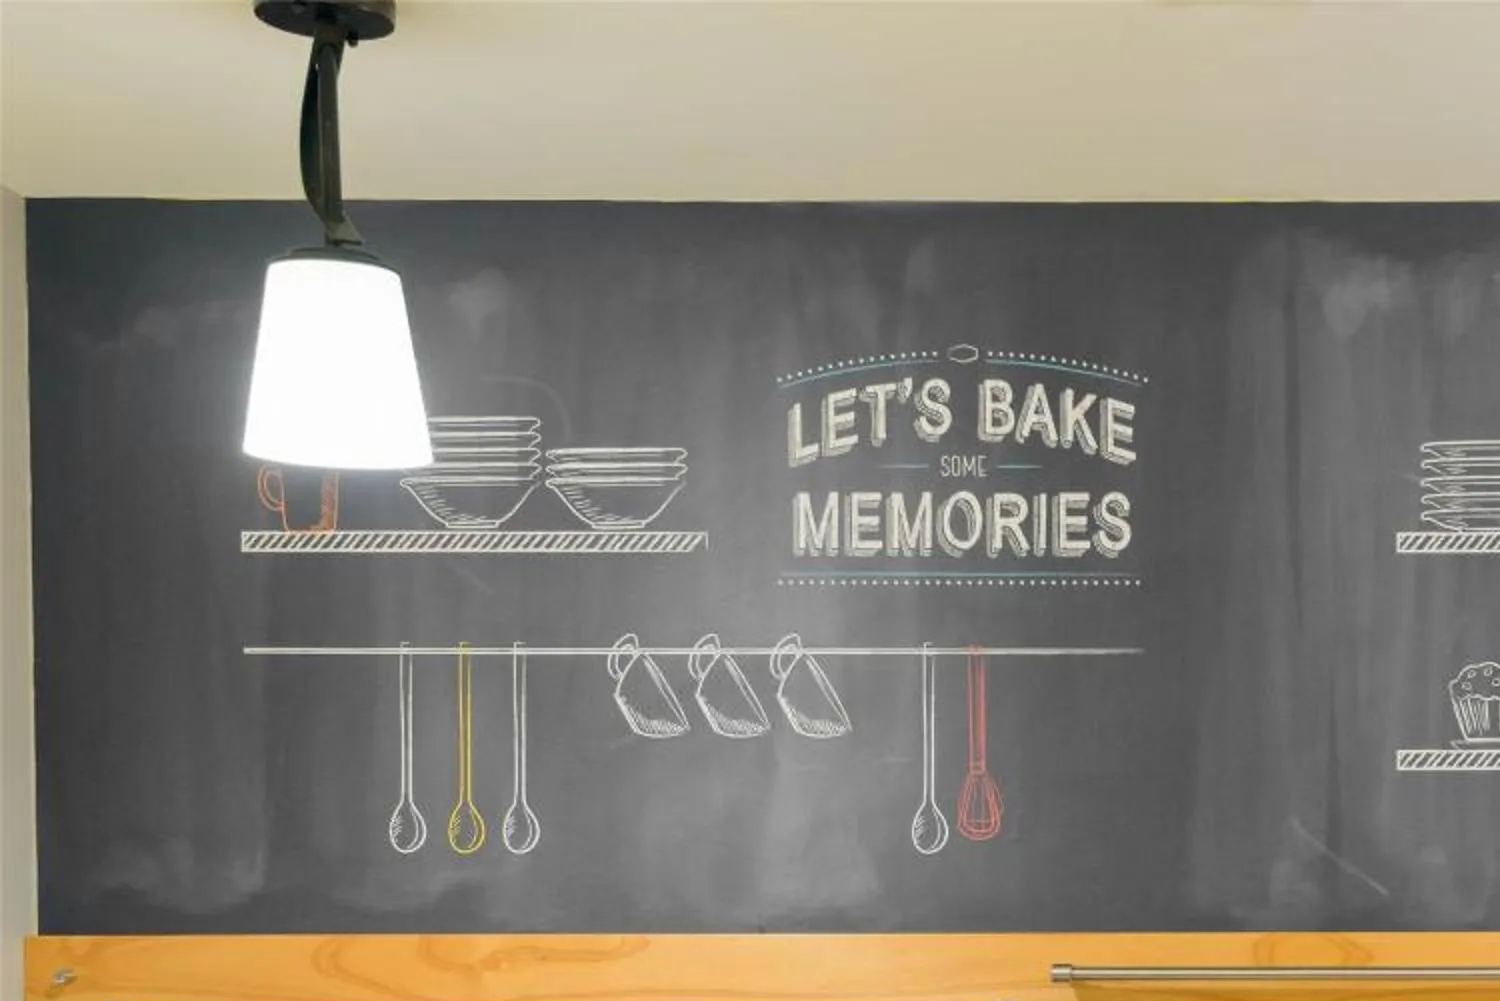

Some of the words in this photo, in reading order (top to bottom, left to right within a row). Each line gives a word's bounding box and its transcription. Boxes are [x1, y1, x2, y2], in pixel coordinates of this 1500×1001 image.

[787, 376, 952, 468] LET'S
[977, 378, 1137, 465] BAKE
[940, 454, 988, 478] SOME
[792, 490, 1132, 559] MEMORIES
